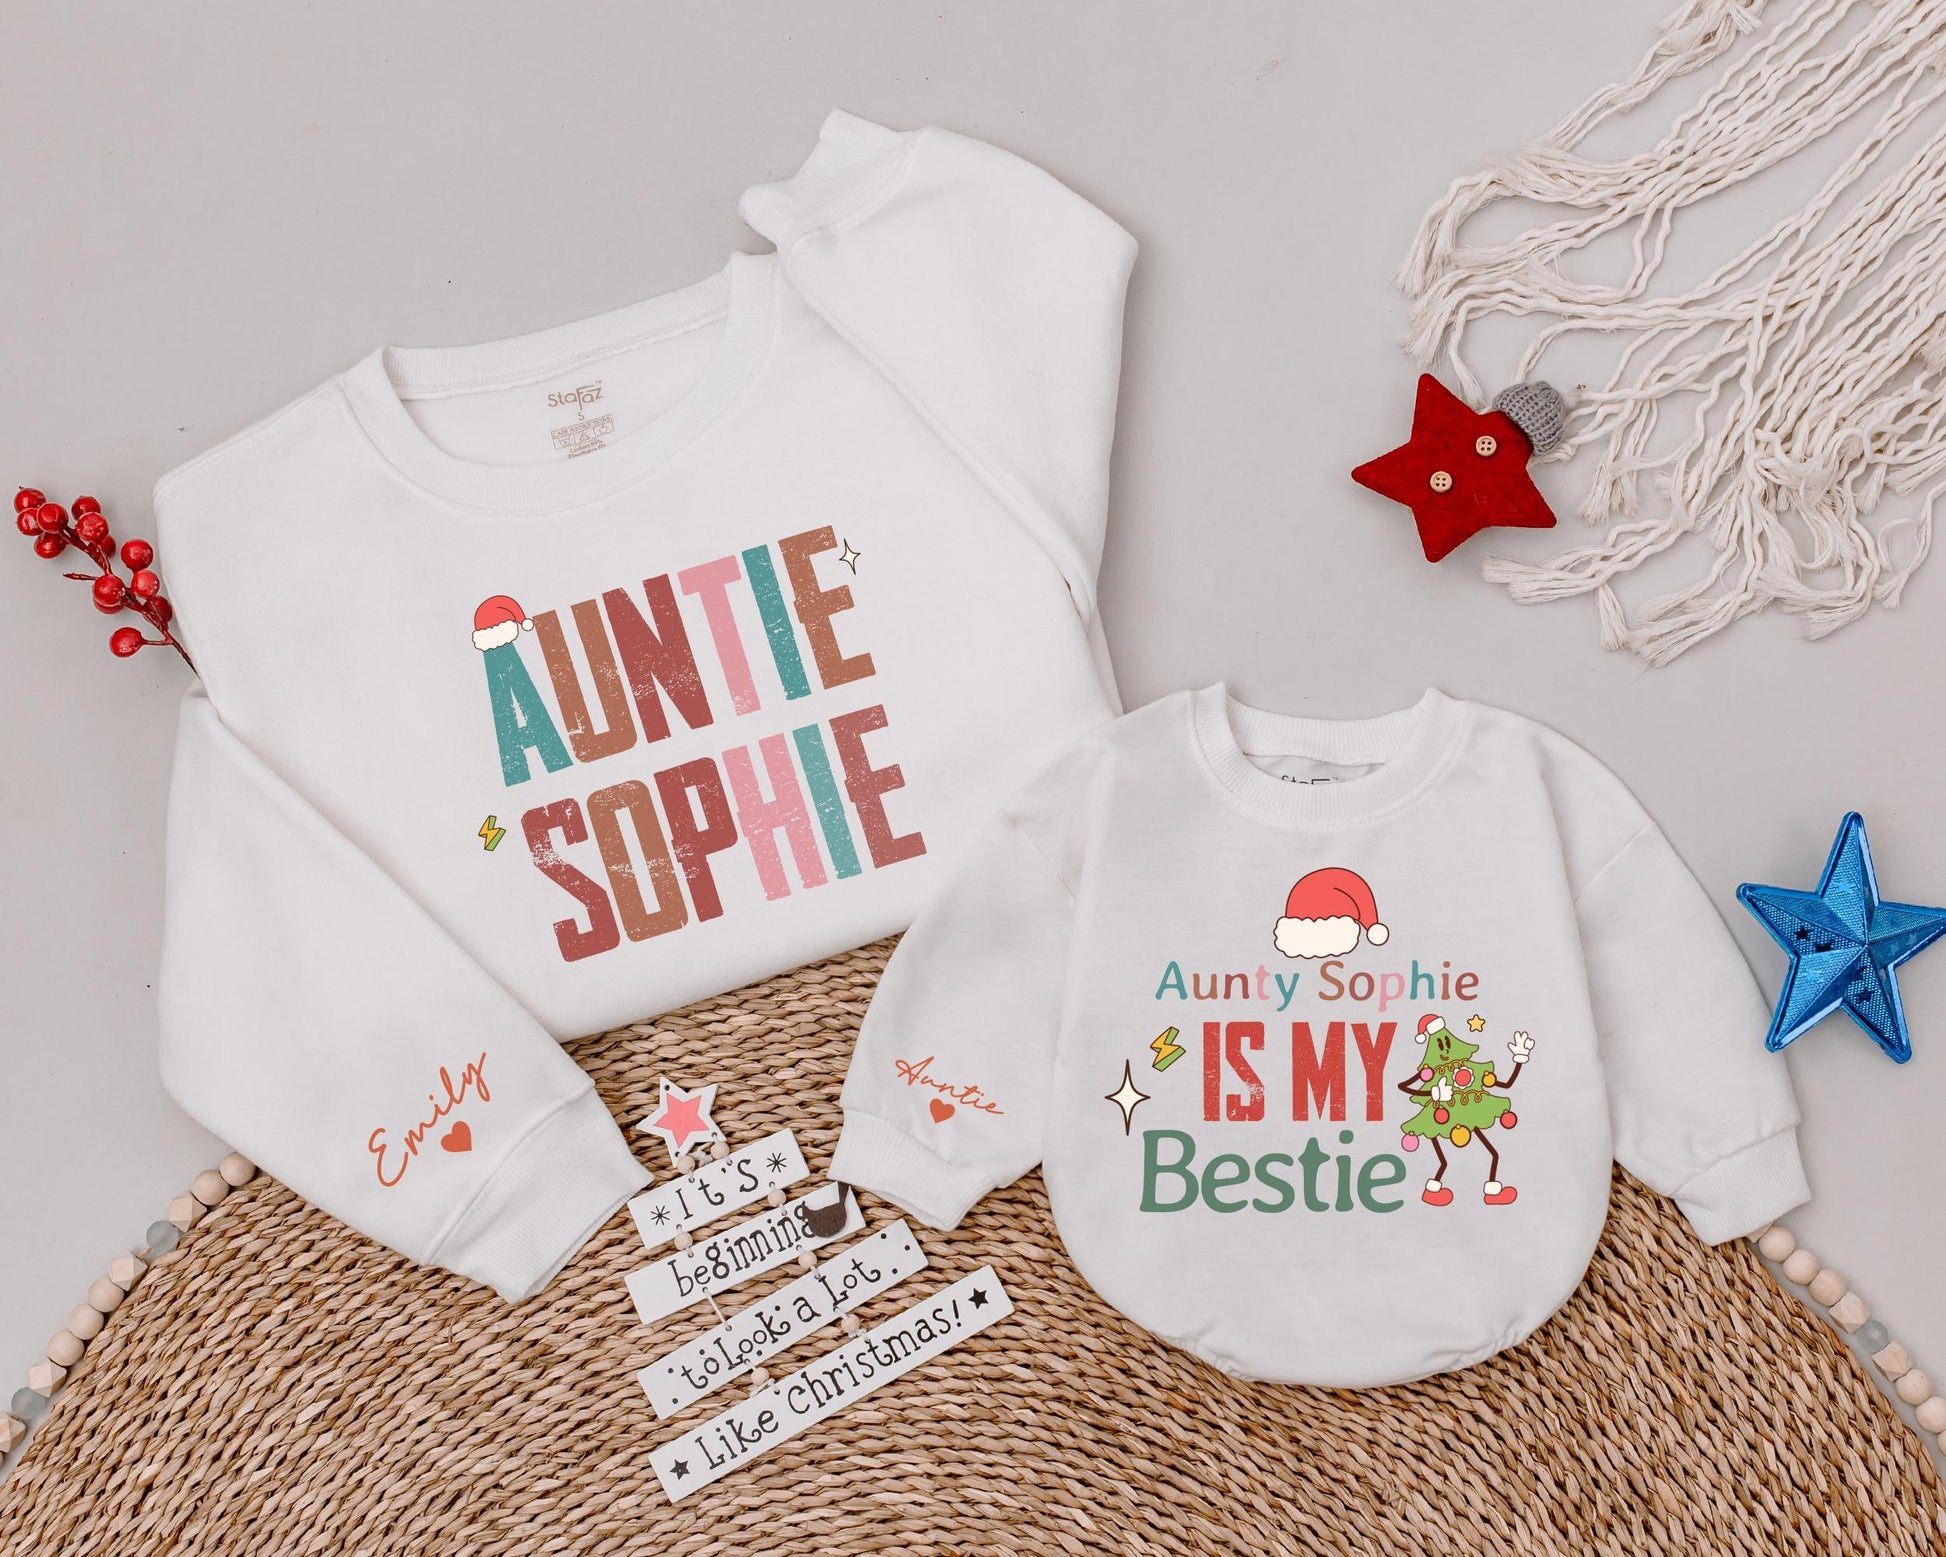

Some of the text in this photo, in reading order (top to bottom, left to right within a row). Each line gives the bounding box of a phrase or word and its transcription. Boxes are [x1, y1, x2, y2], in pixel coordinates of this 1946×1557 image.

[577, 411, 585, 421] S
[483, 525, 876, 787] AUNTIE
[521, 704, 927, 963] SOPHIE
[1155, 960, 1480, 1013] Aunty Sophie
[895, 1056, 1004, 1114] Auntie
[1203, 1021, 1398, 1122] IS MY
[368, 1052, 491, 1188] Emily
[1139, 1129, 1407, 1213] Bestie
[680, 1356, 720, 1390] to
[713, 1311, 791, 1371] Look
[793, 1295, 822, 1323] a
[694, 1408, 779, 1471] Like
